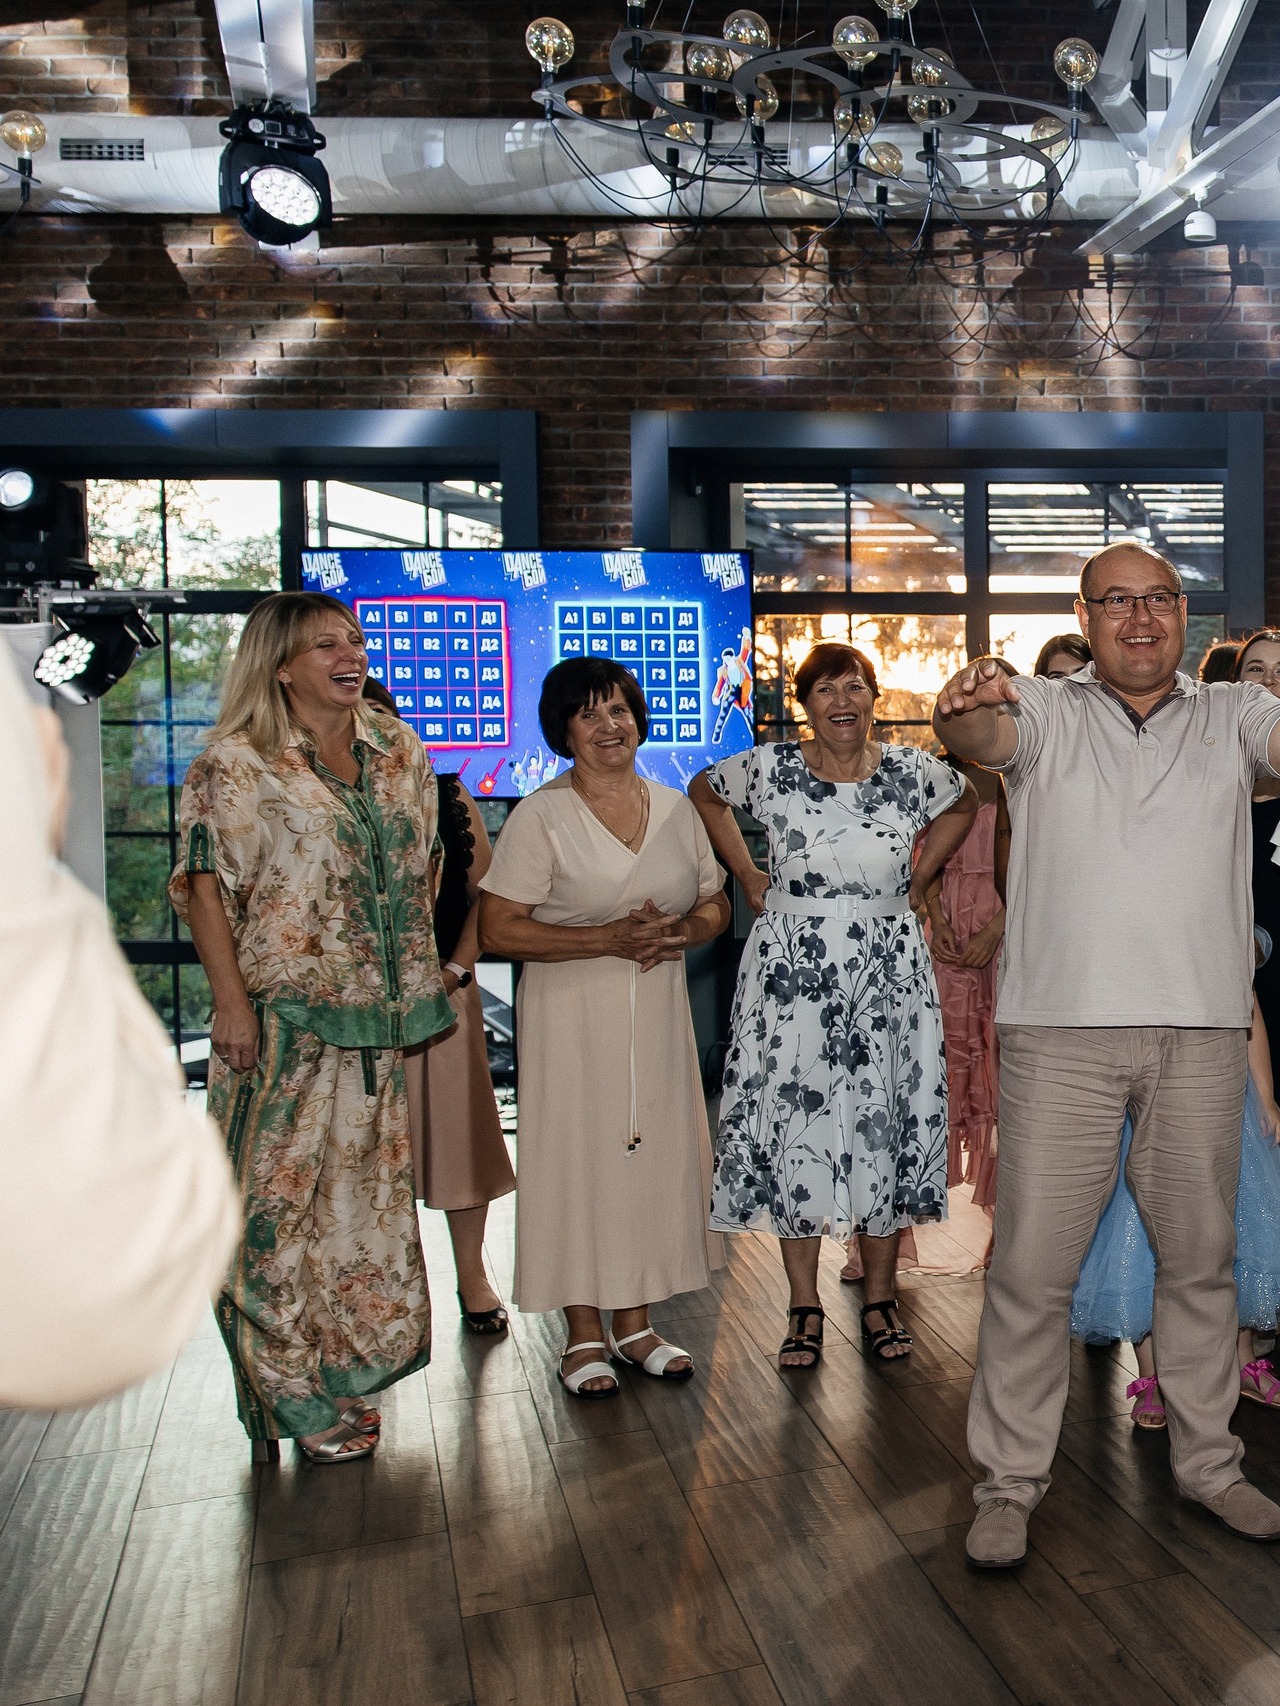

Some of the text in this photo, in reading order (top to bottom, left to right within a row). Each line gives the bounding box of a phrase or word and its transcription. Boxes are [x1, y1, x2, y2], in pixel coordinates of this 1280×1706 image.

[301, 552, 341, 579] DANCE
[403, 551, 443, 578] DANCE
[502, 552, 543, 578] DANCE
[604, 552, 643, 579] DANCE
[703, 553, 742, 580] DANCE
[366, 611, 496, 625] А1 Б1 В1 Г1 Д1
[564, 612, 692, 626] А1 Б1 В1 Г1 Д1
[366, 638, 498, 652] А2 Б2 В2 Г2 Д2
[564, 639, 695, 653] А2 Б2 В2 Г2 Д2
[368, 667, 499, 681] А3 Б3 В3 Г3 Д3
[652, 668, 666, 680] Г3
[678, 669, 695, 682] Д3
[396, 696, 501, 709] Б4 В4 Г4 Д4
[653, 697, 697, 710] Г4 Д4
[426, 724, 443, 735] В5
[457, 724, 471, 735] Г5
[483, 724, 501, 737] Д5
[653, 724, 697, 737] Г5 Д5
